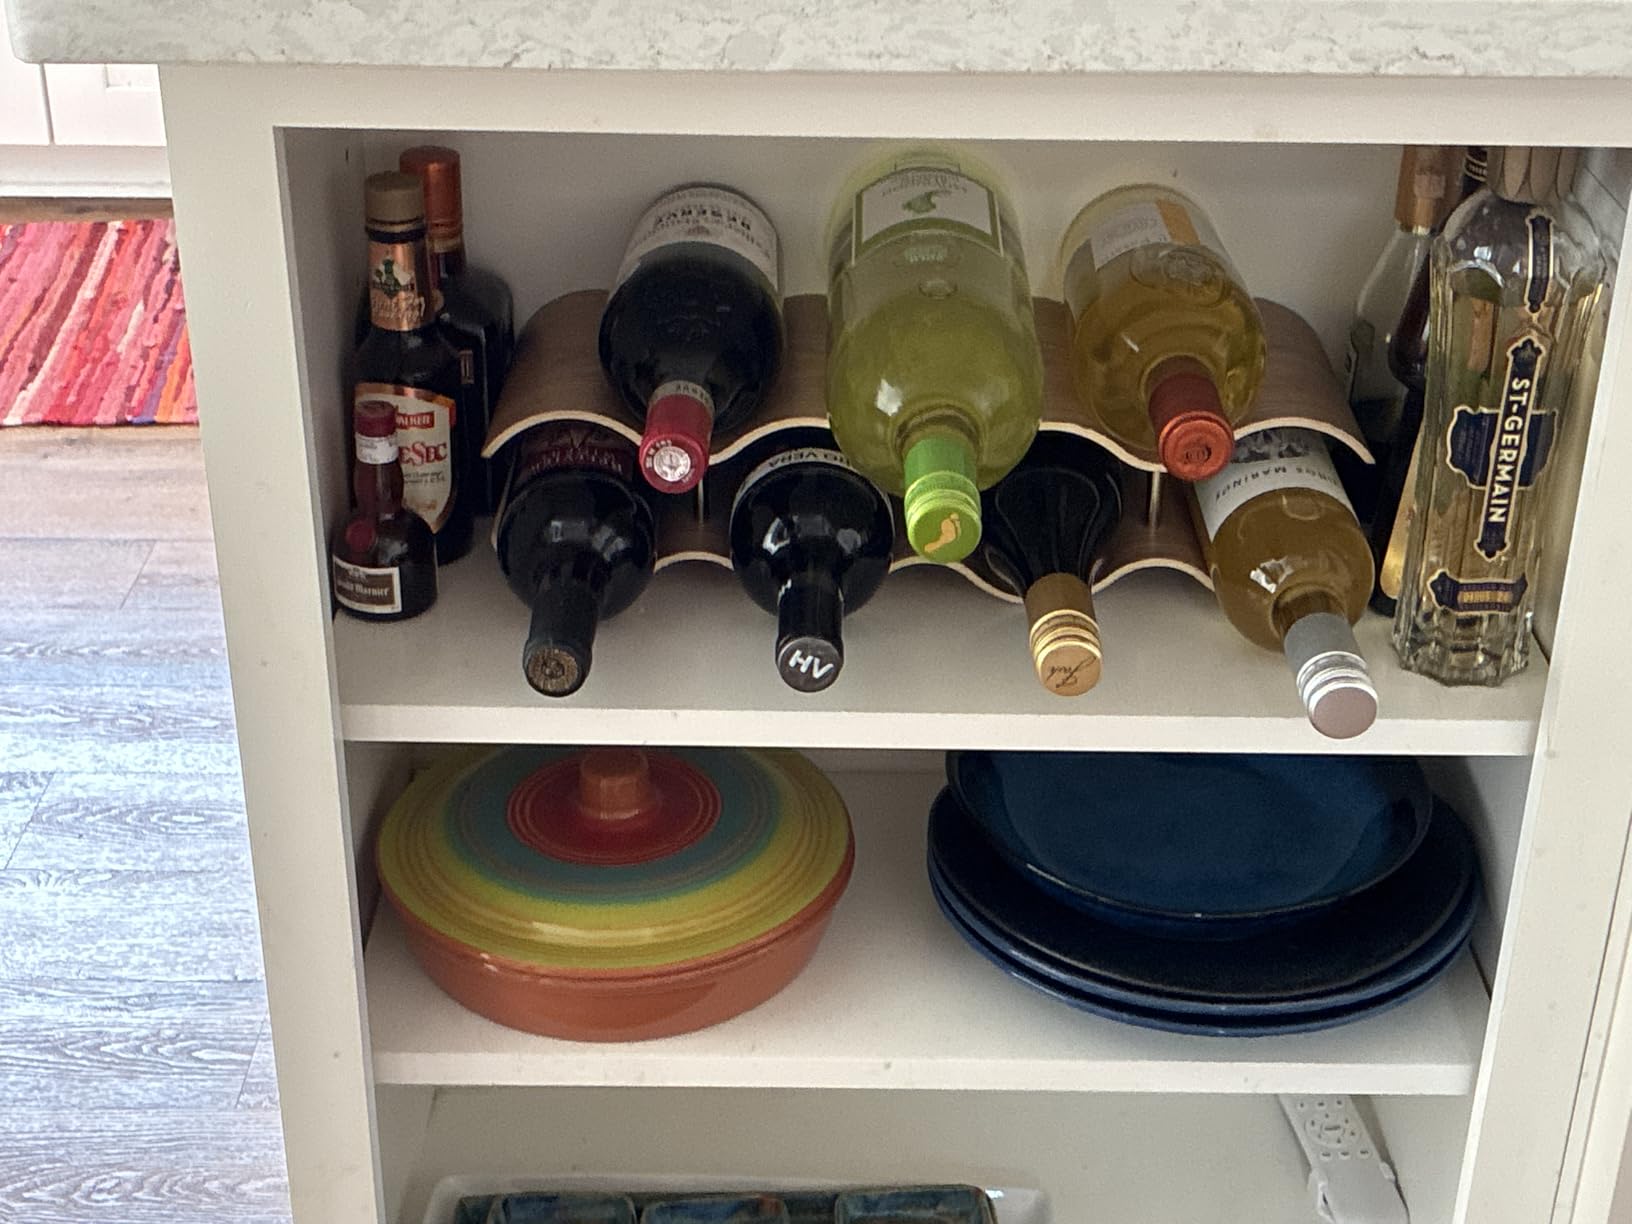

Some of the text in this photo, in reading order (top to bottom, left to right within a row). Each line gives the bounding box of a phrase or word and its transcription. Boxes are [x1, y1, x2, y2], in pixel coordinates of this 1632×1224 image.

[397, 414, 431, 426] ALKER
[1488, 377, 1531, 523] ST-GERMAIN
[788, 649, 834, 679] HV
